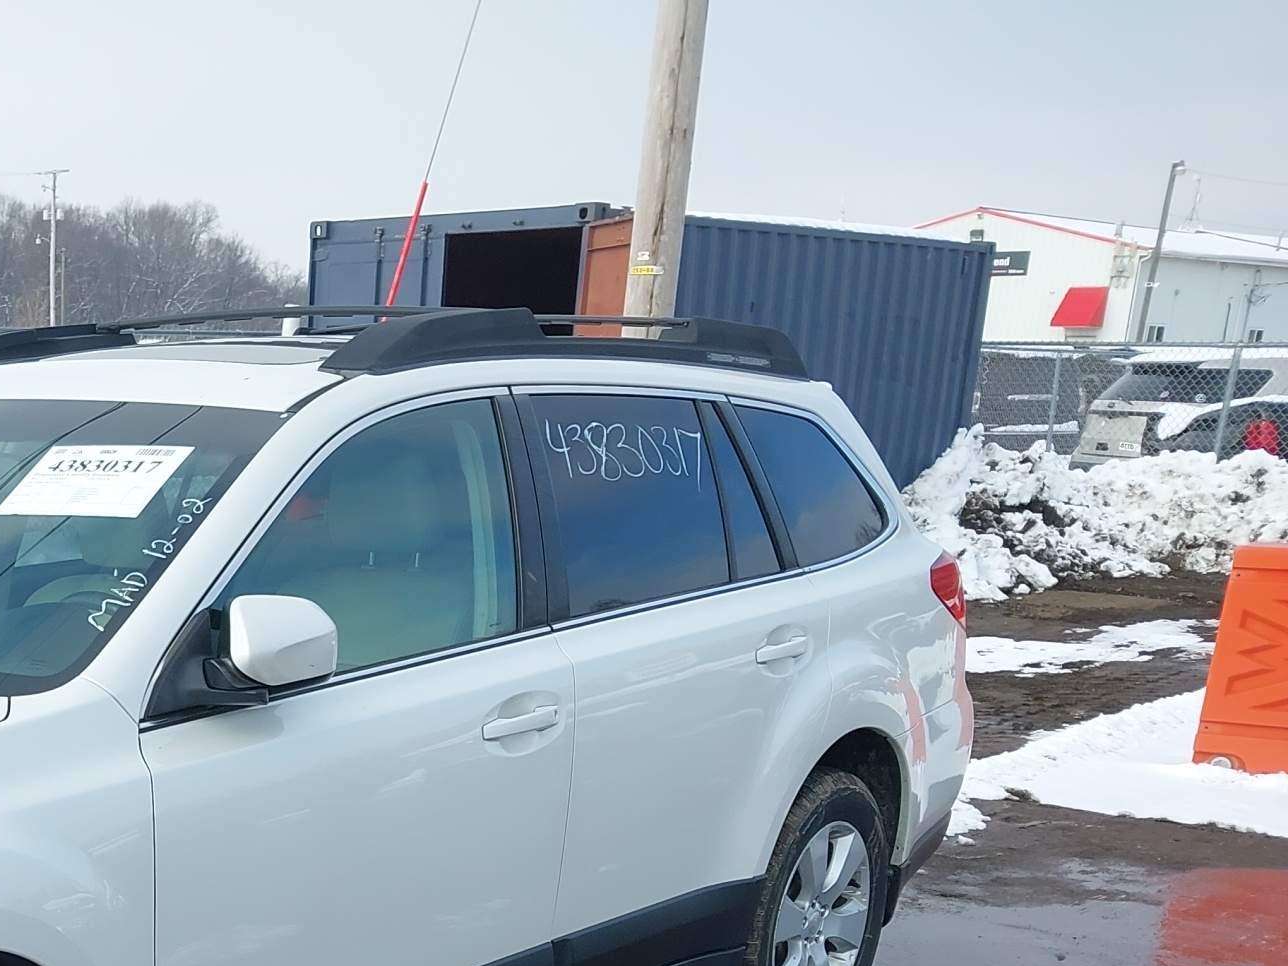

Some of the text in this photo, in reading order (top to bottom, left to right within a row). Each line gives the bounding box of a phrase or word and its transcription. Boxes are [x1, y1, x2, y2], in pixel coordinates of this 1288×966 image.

[48, 459, 163, 473] 43830317
[545, 418, 701, 492] 43830317
[142, 497, 213, 559] 12-02
